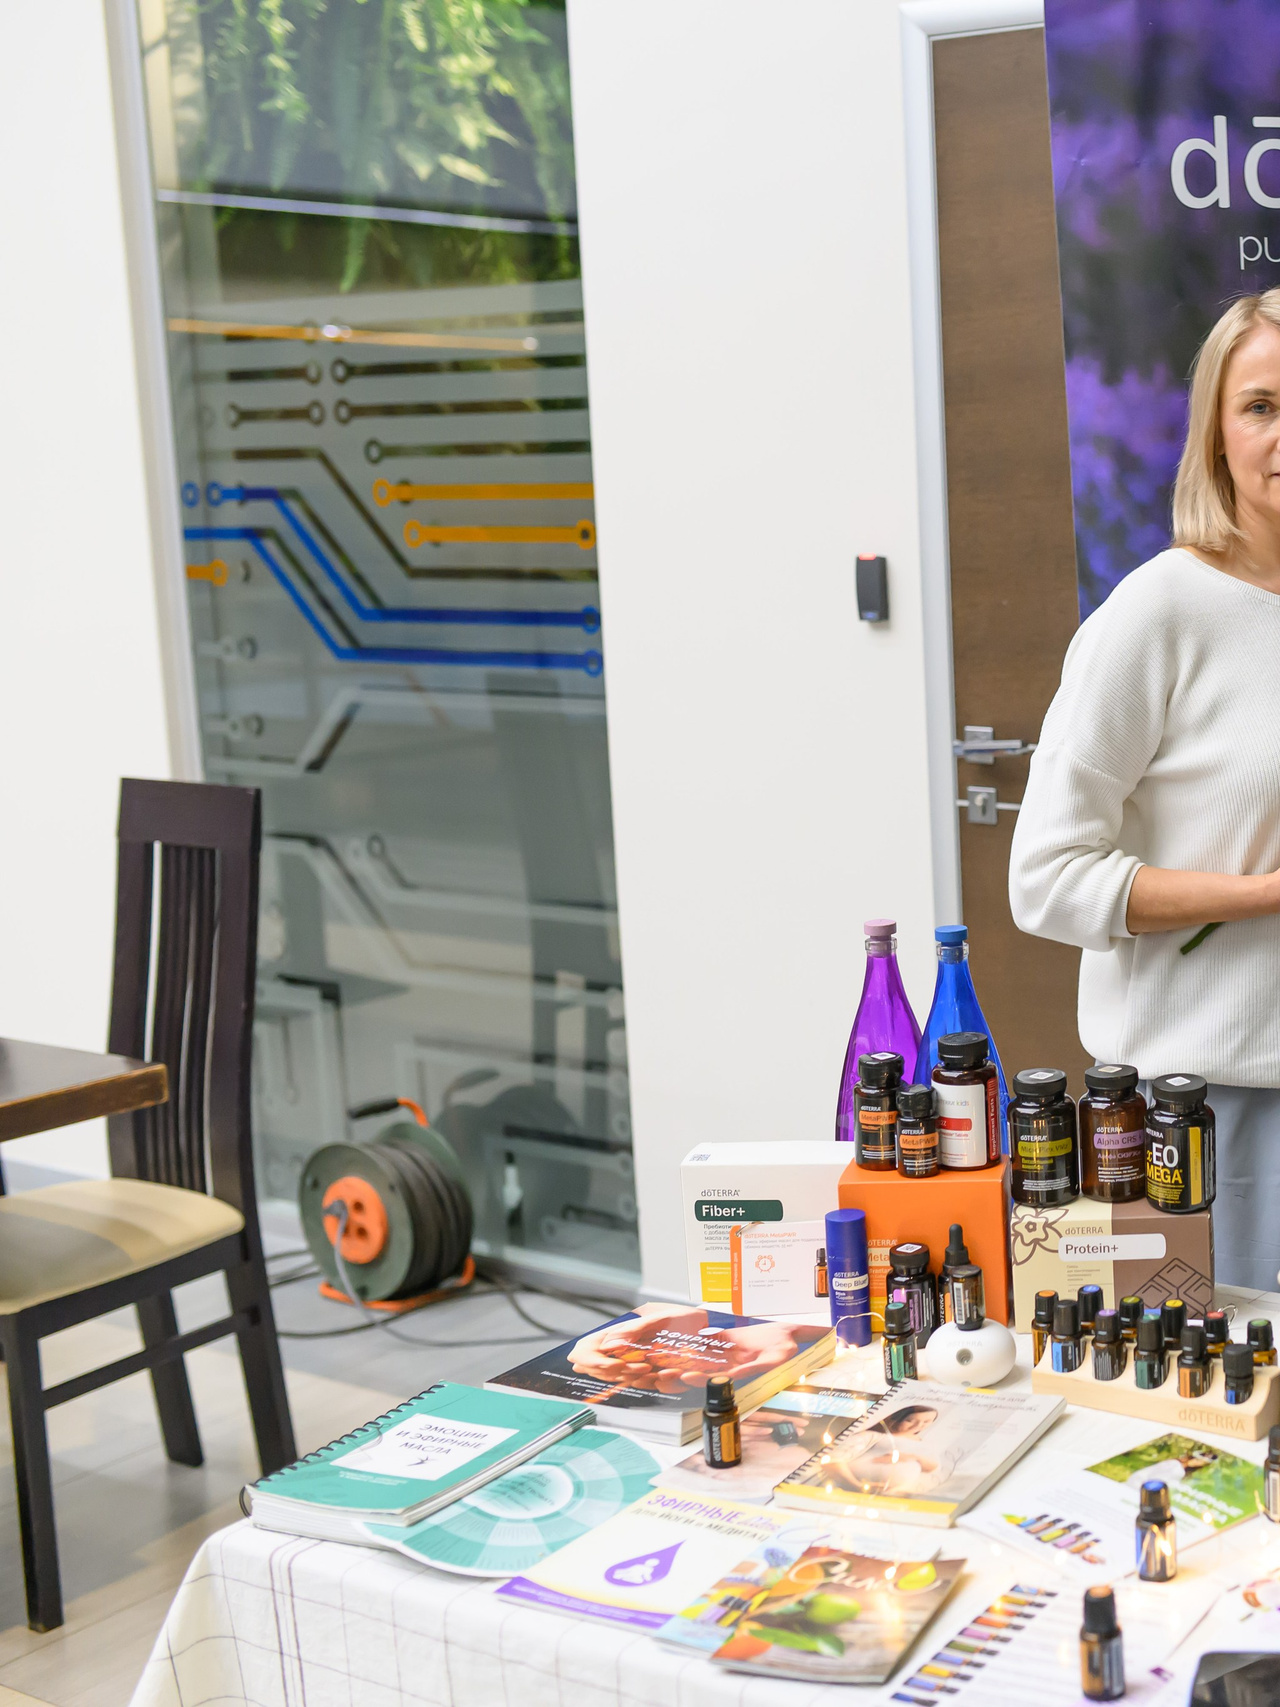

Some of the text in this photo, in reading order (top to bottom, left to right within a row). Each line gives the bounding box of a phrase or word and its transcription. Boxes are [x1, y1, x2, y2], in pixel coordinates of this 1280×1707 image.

[902, 1137, 936, 1145] MetaPWR
[1097, 1137, 1120, 1146] Alpha
[702, 1205, 746, 1217] Fiber+
[1065, 1227, 1104, 1235] dōTERRA
[1065, 1243, 1119, 1255] Protein+
[835, 1281, 853, 1289] Deep
[651, 1337, 707, 1353] МАСЛА
[657, 1329, 736, 1349] ЭФИРНЫЕ
[1178, 1408, 1246, 1432] dōTERRA
[420, 1424, 488, 1439] ЭМОЦИИ
[411, 1433, 487, 1449] ЭФИРНЫЕ
[400, 1442, 452, 1455] МАСЛА
[647, 1494, 746, 1524] ЭФИРНЫЕ
[705, 1522, 770, 1542] МЕДИТАЦ
